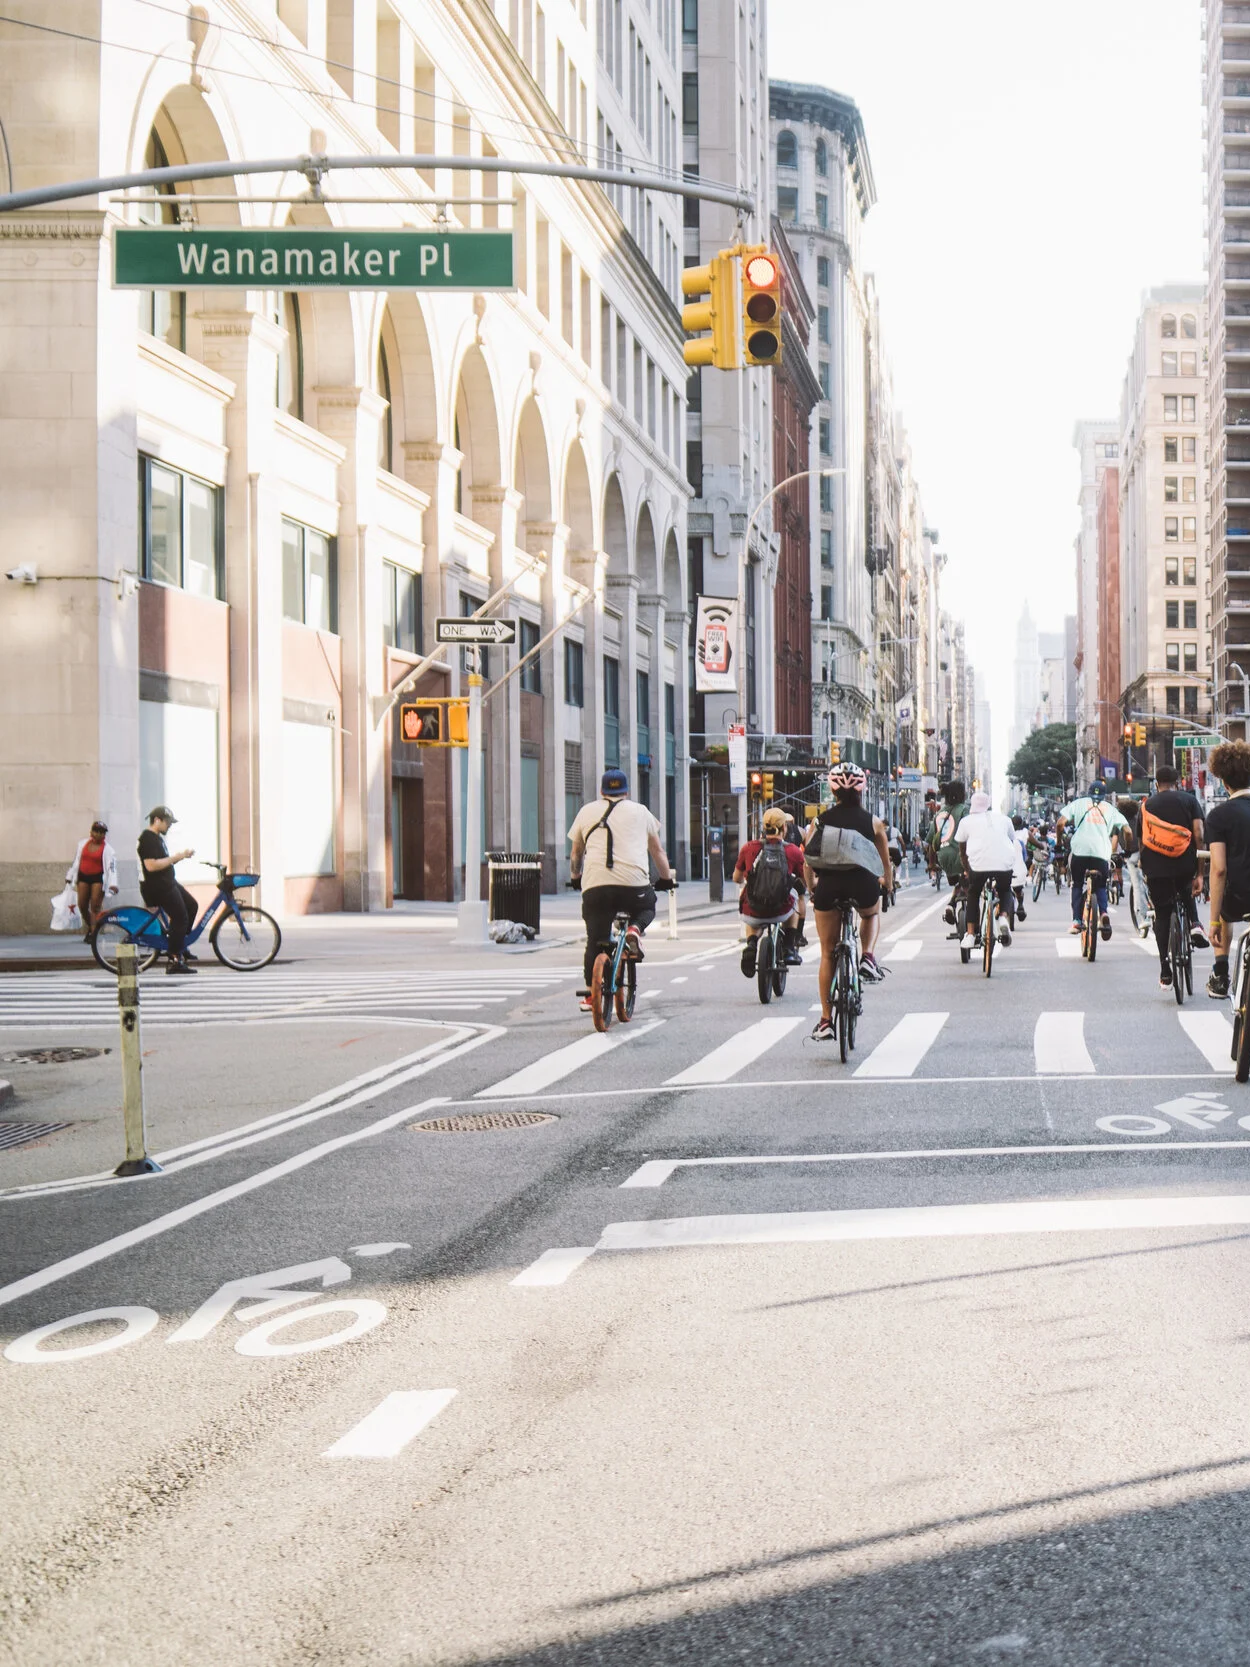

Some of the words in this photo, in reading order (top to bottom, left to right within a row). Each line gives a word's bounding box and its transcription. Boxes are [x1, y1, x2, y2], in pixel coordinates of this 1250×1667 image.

[177, 242, 401, 277] Wanamaker
[420, 244, 452, 277] Pl
[443, 625, 467, 636] ONE
[480, 626, 505, 636] WAY
